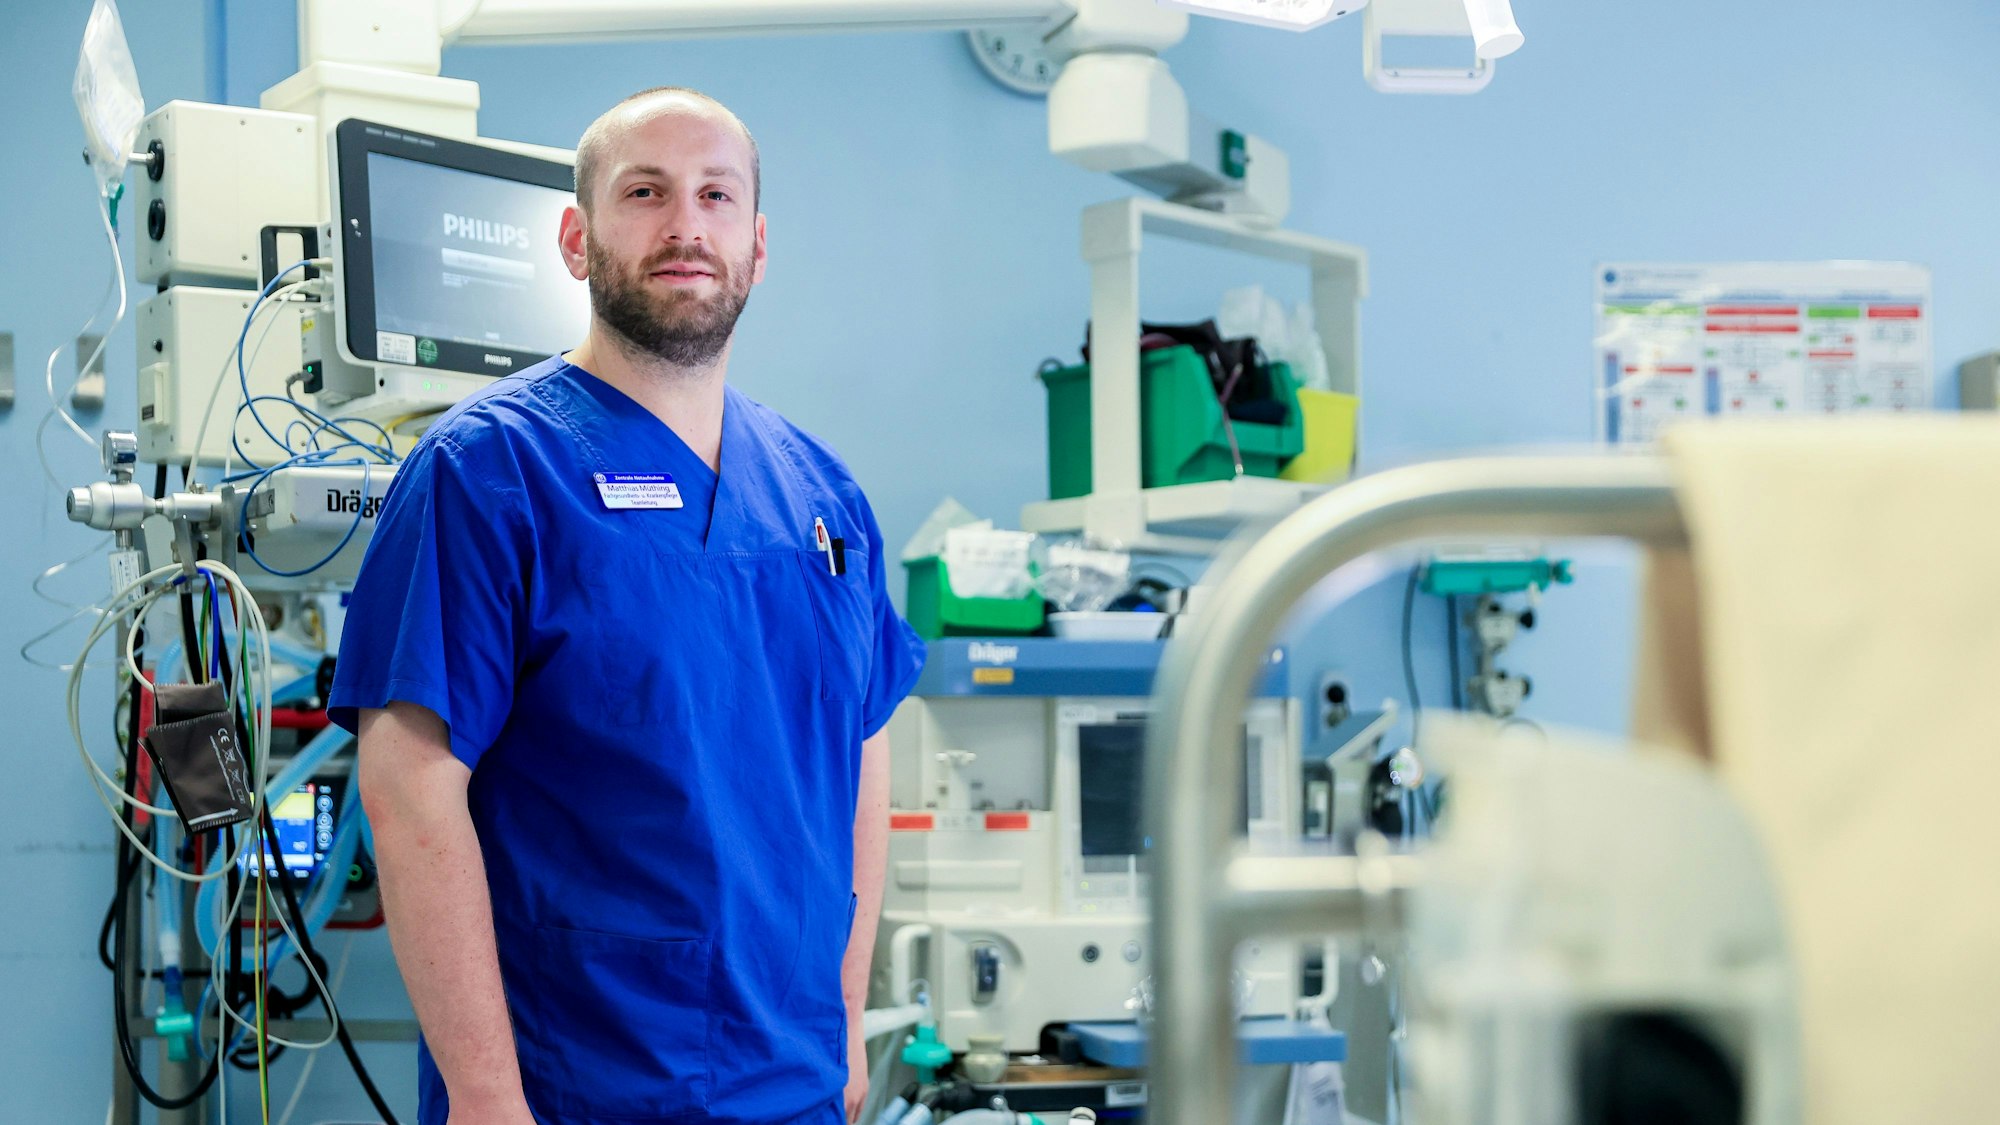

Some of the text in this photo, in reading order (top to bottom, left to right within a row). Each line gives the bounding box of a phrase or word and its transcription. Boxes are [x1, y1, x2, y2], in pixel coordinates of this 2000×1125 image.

[443, 212, 530, 249] PHILIPS
[484, 353, 512, 367] PHILIPS
[327, 489, 384, 518] Dräge
